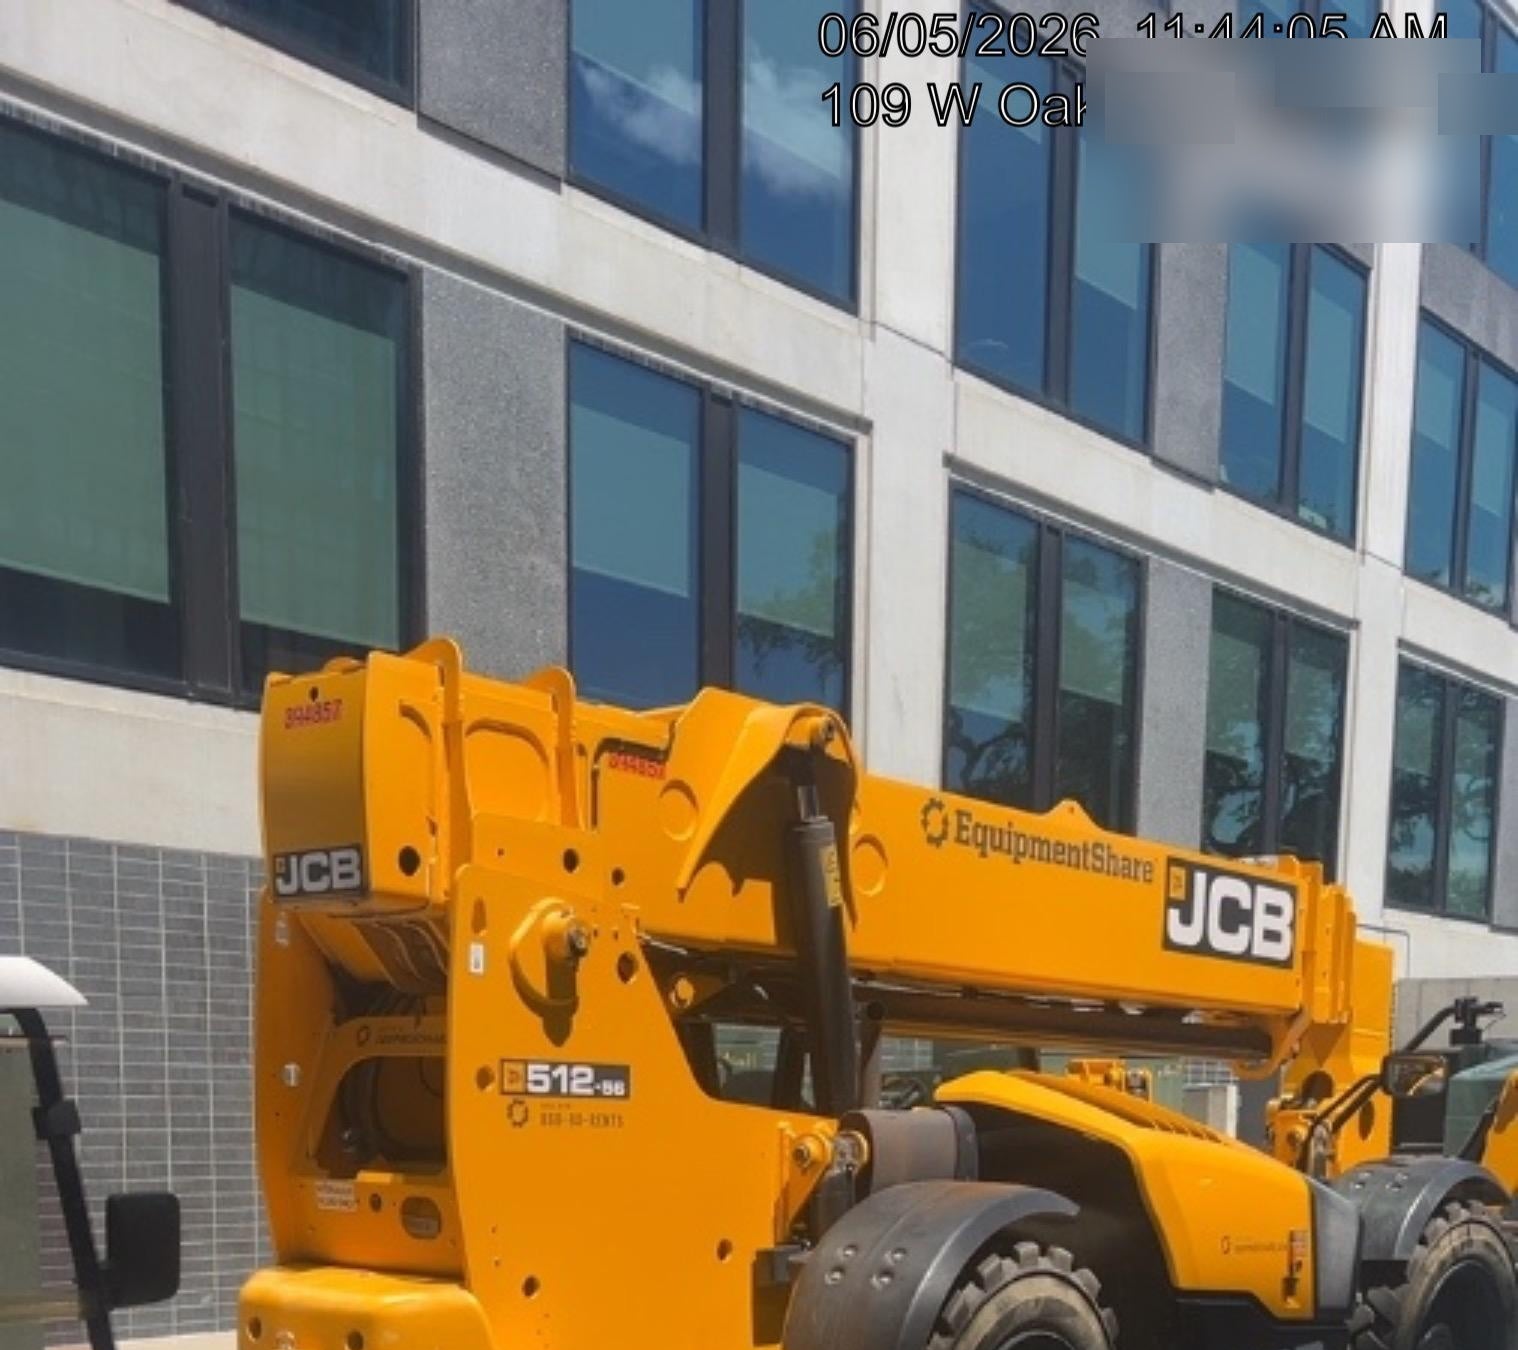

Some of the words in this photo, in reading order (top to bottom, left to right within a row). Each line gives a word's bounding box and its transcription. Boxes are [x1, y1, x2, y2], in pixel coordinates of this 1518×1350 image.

[275, 848, 361, 895] JCB
[955, 809, 1154, 884] EquipmentShare
[1166, 869, 1294, 961] JCB
